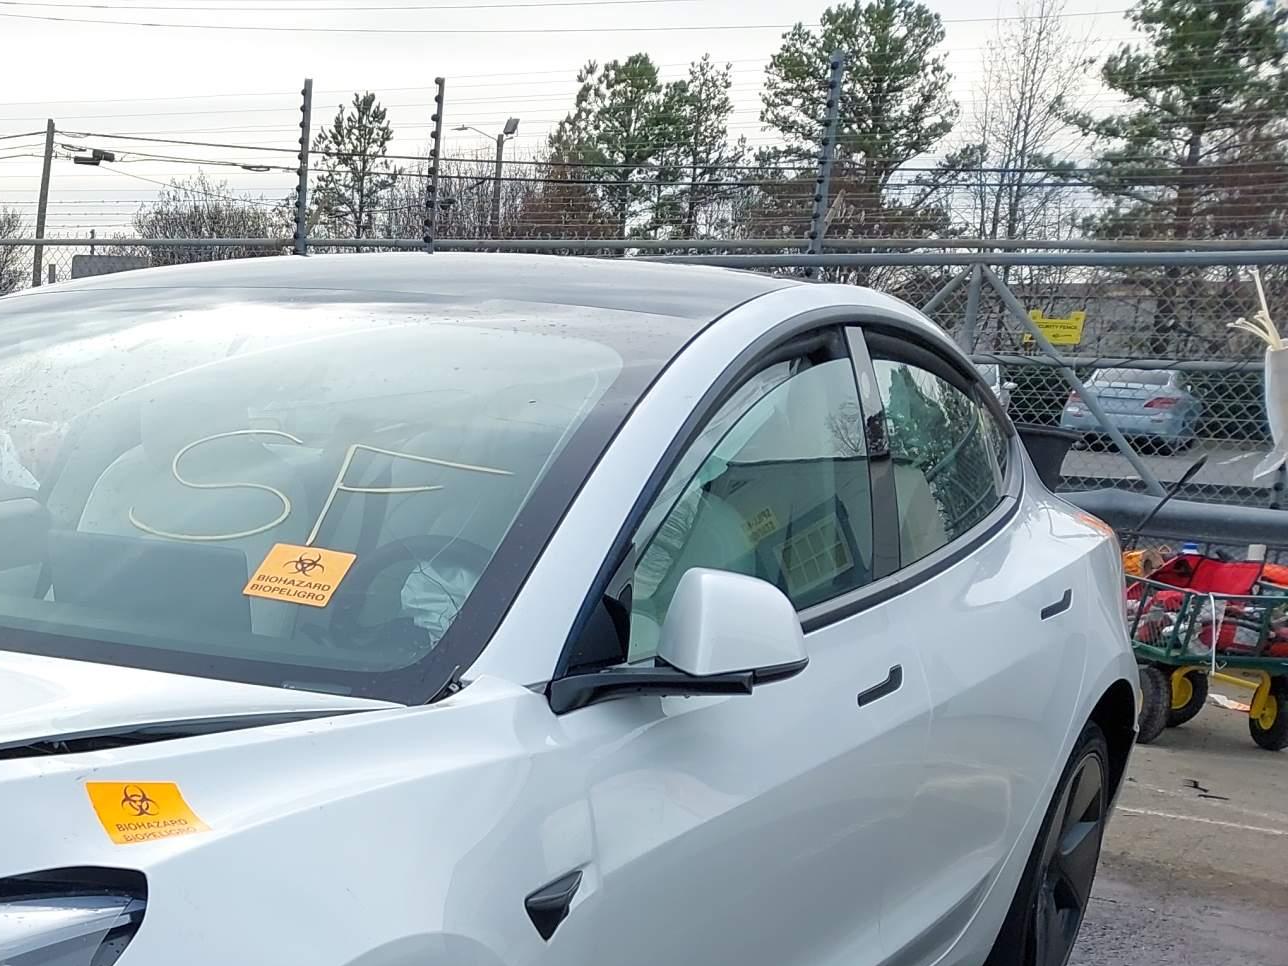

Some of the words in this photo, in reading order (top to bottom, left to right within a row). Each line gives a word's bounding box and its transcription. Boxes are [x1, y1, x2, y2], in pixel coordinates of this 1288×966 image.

[128, 429, 515, 546] SF
[256, 574, 332, 592] BIOHAZARD
[249, 583, 326, 602] BIOPELIGRO
[115, 818, 189, 832] BIOHAZARD
